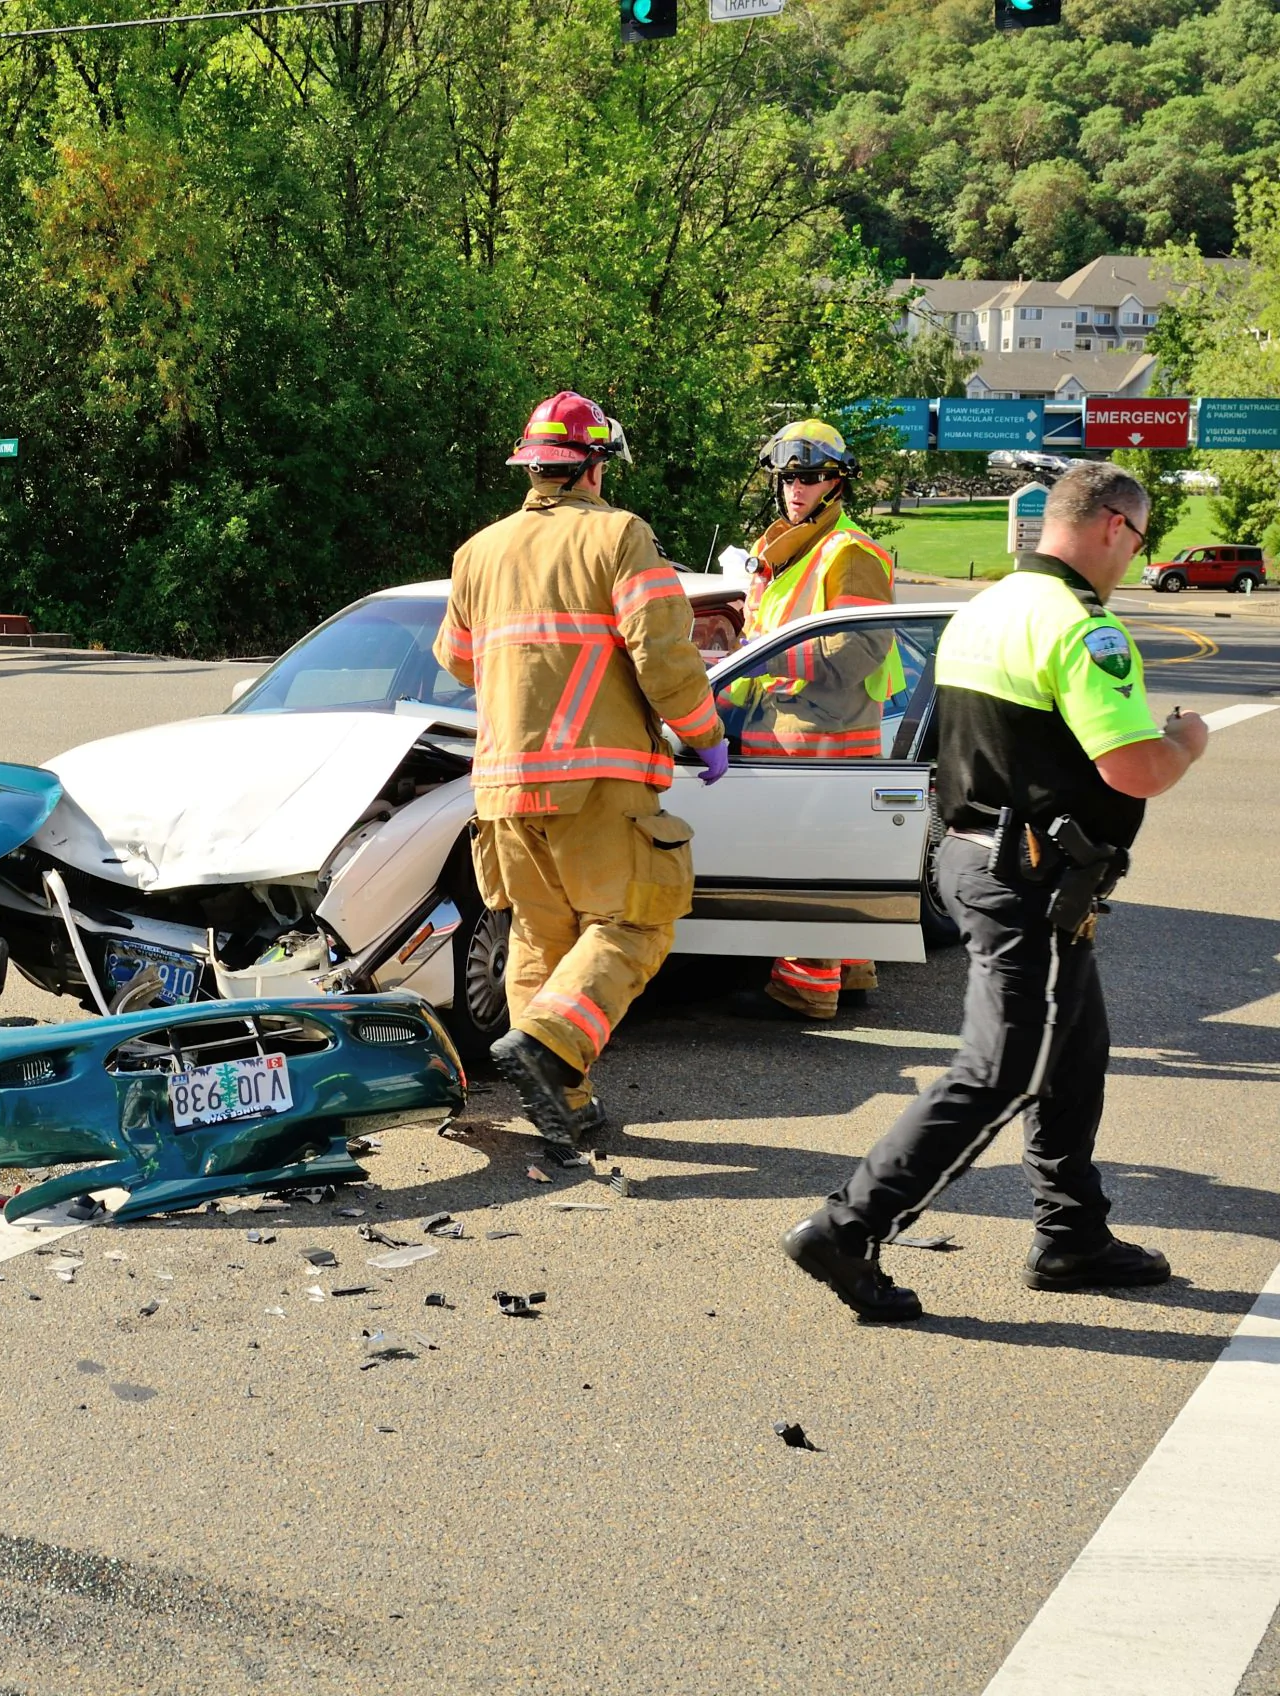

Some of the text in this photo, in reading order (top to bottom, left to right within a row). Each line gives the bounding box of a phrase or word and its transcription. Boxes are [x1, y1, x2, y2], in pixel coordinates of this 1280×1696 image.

[969, 407, 995, 415] HEART
[1206, 403, 1280, 412] PATIENT ENTRANCE
[952, 415, 993, 423] VASCULAR
[1085, 411, 1188, 424] EMERGENCY
[1213, 411, 1248, 419] PARKING
[944, 431, 1020, 440] HUMAN RESOURCES
[1205, 427, 1278, 436] VISITOR ENTRANCE
[174, 1080, 222, 1116] 938
